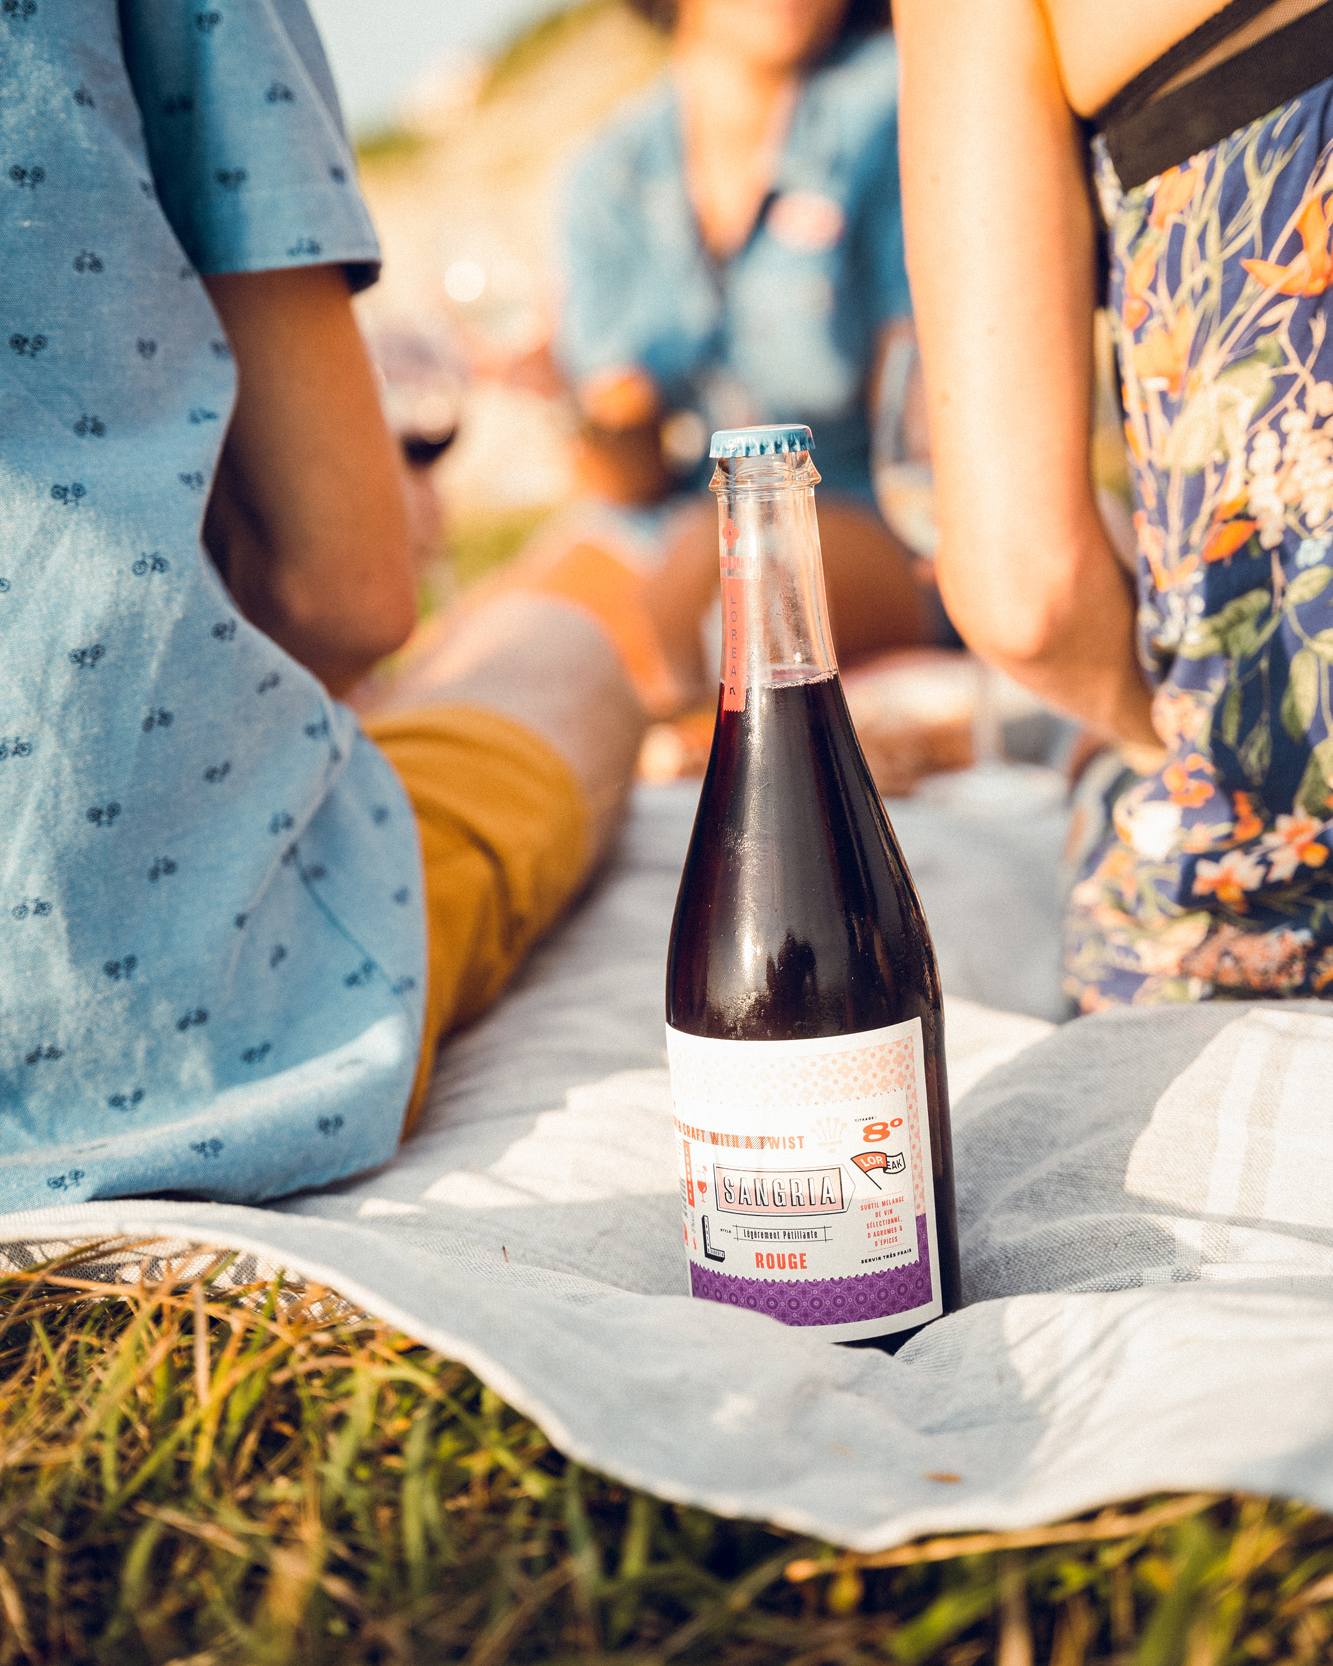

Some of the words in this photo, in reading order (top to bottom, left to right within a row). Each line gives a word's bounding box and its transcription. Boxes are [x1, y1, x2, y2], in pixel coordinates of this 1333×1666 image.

[709, 1131, 740, 1149] WITH
[744, 1136, 753, 1149] A
[757, 1136, 804, 1150] TWIST
[723, 1175, 837, 1207] SANGRIA
[755, 1252, 808, 1269] ROUGE
